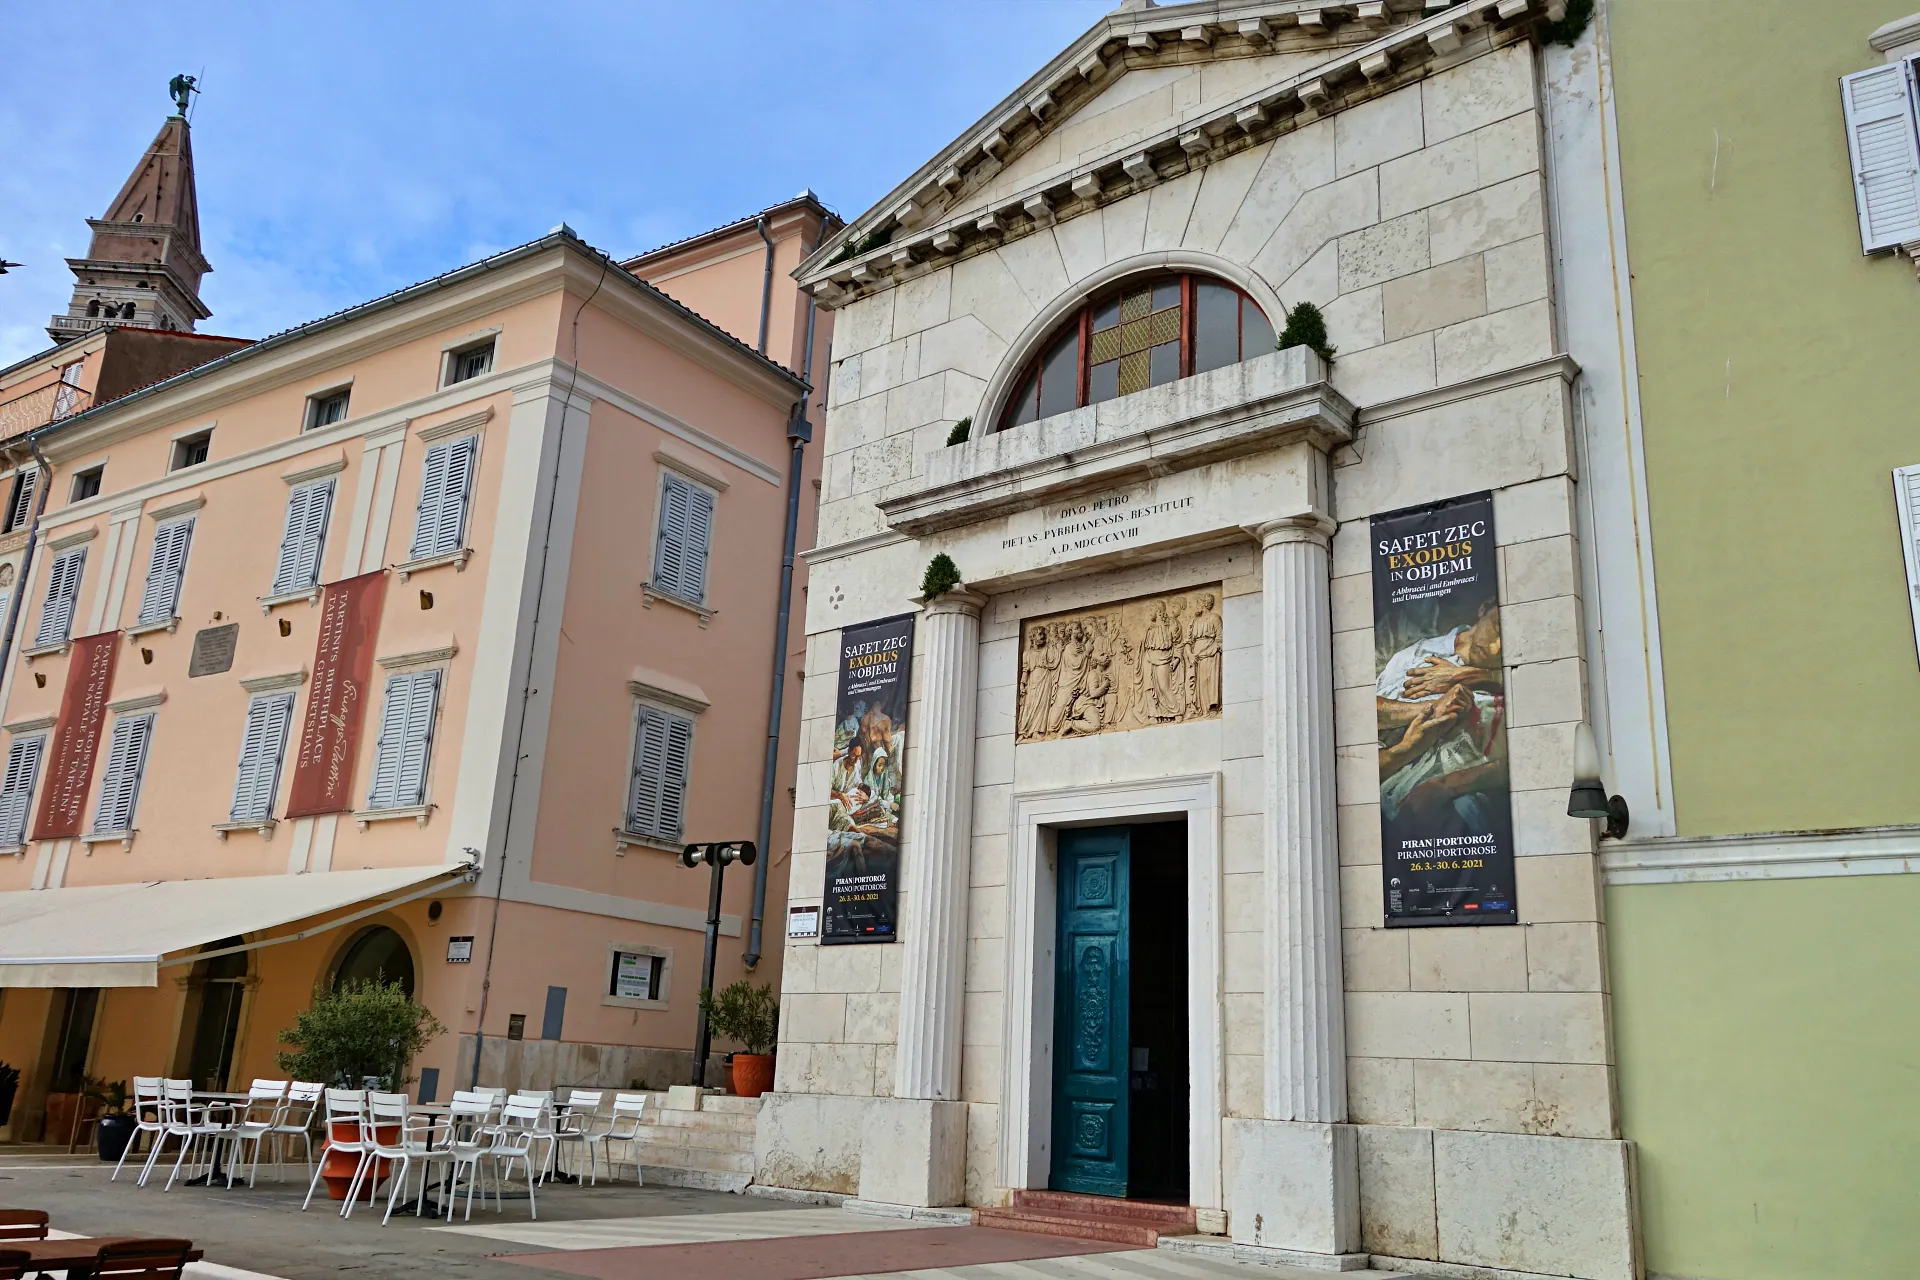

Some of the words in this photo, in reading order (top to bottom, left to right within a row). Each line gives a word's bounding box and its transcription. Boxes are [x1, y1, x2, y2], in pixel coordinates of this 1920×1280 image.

[1093, 494, 1129, 512] PETRO
[1379, 530, 1441, 556] SAFET
[1445, 520, 1486, 543] ZEC
[1388, 540, 1473, 569] EXODUS
[1390, 571, 1404, 582] IN
[1406, 556, 1473, 581] OBJEMI
[1392, 595, 1404, 603] und
[1406, 588, 1452, 600] Umarmungen
[1396, 584, 1426, 596] Abbracci
[1429, 581, 1442, 590] and
[1443, 576, 1475, 588] Embraces
[320, 594, 336, 653] TARTINI
[90, 644, 102, 676] CASA
[844, 640, 881, 658] SAFET
[883, 636, 907, 650] ZEC
[849, 650, 898, 669] EXODUS
[91, 642, 112, 724] TARTINIJEVA
[849, 670, 856, 679] IN
[857, 662, 897, 678] OBJEMI
[80, 683, 95, 733] NATALE
[300, 660, 325, 768] GEBURTSHAUS
[312, 668, 336, 764] BIRTHPLACE
[74, 739, 84, 753] DI
[76, 731, 96, 788] ROJSTNA
[60, 758, 80, 812] TARTINI
[1397, 850, 1433, 860] PIRANO
[1437, 845, 1497, 858] PORTOROSE
[1402, 838, 1432, 849] PIRAN
[1436, 832, 1494, 847] PORTOROŽ
[1462, 860, 1484, 868] 2021
